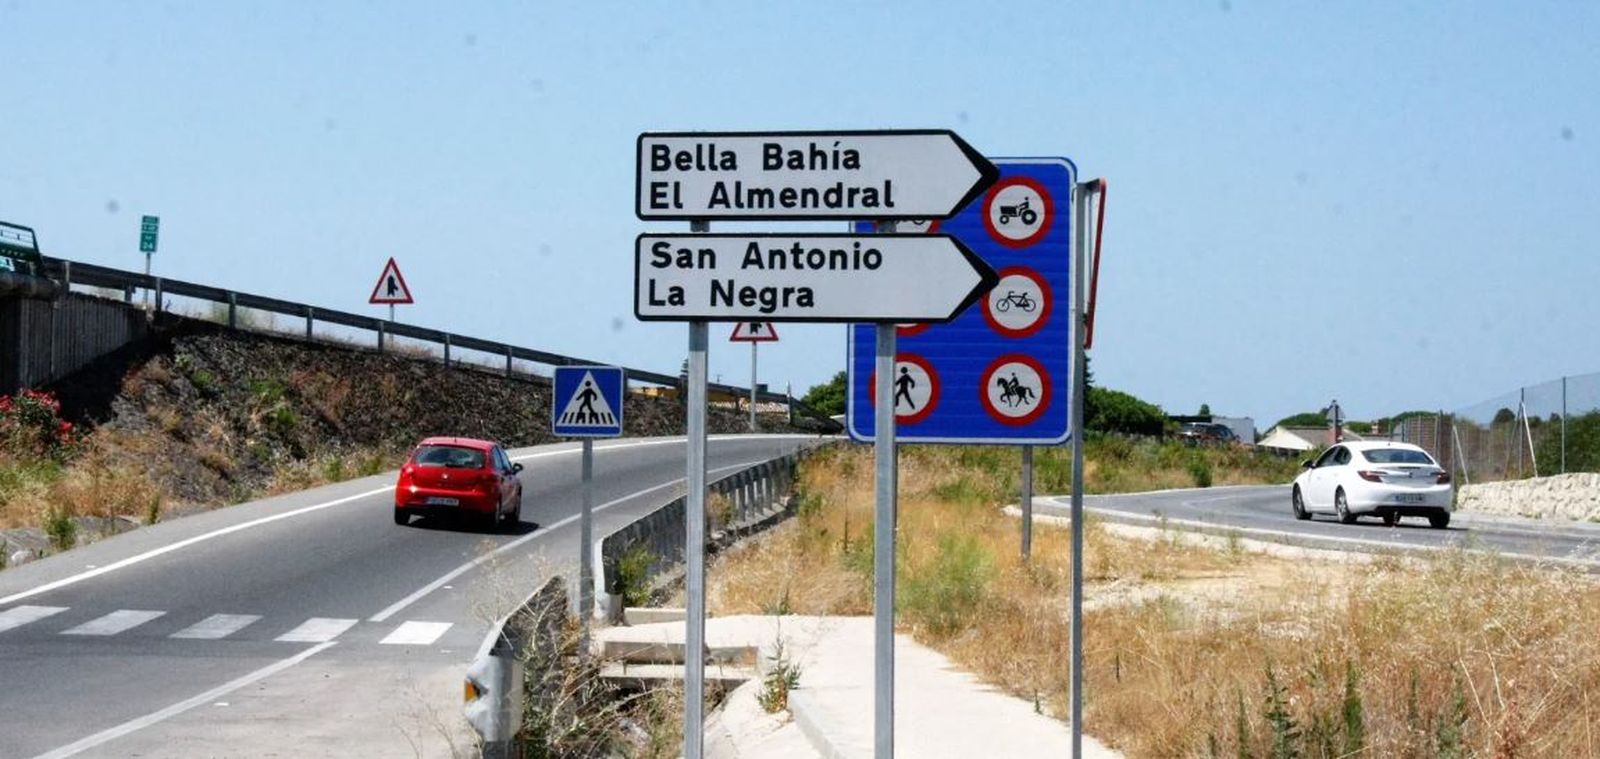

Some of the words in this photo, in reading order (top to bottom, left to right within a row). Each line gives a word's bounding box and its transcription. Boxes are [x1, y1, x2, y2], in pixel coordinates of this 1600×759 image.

[650, 143, 738, 172] Bella
[762, 140, 861, 172] Bahía
[649, 181, 684, 210] El
[707, 179, 895, 210] Almendral
[650, 241, 717, 271] San
[740, 241, 883, 271] Antonio
[648, 278, 686, 308] La
[709, 278, 815, 315] Negra
